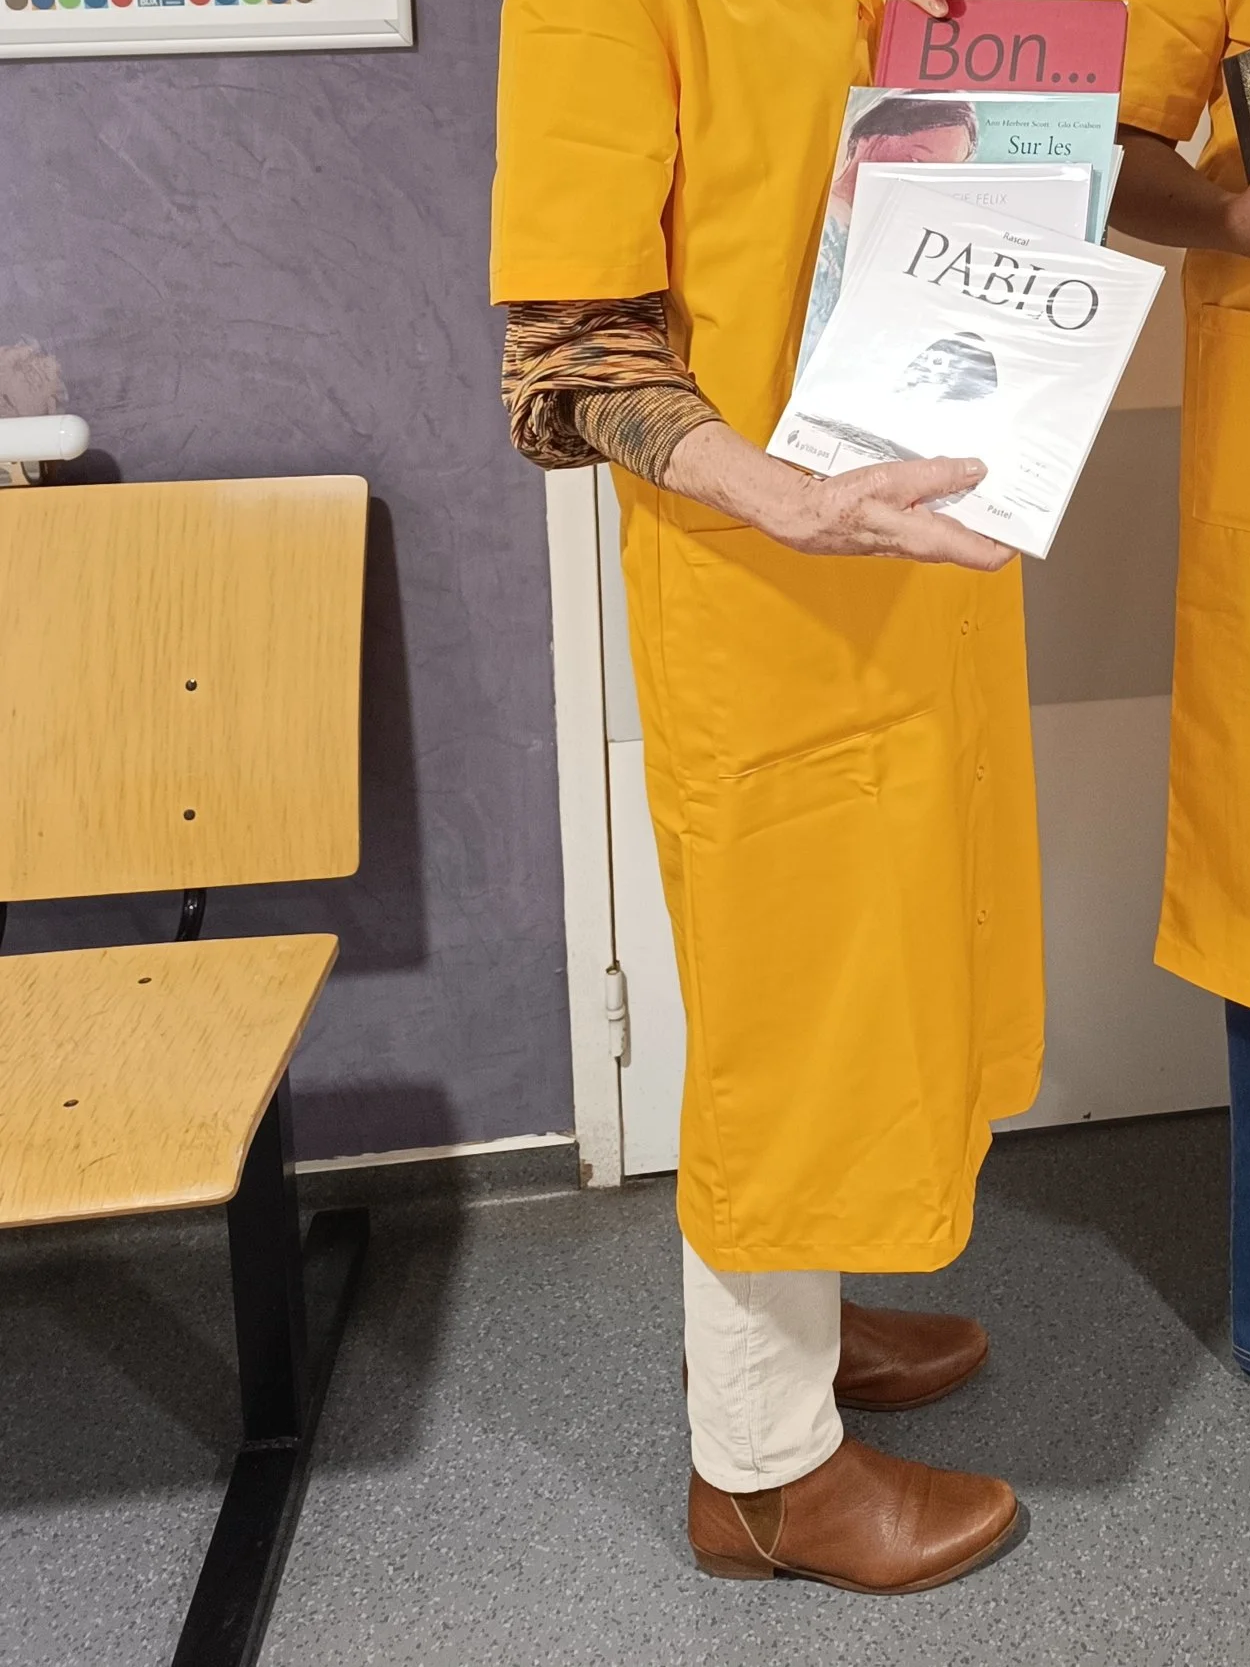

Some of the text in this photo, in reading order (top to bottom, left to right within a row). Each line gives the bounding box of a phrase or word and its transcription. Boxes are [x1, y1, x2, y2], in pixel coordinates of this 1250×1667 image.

[918, 18, 1097, 83] Bon...
[1008, 135, 1072, 156] Sur les
[1003, 231, 1030, 246] Rascal
[903, 227, 1099, 331] PABLO
[987, 504, 1013, 520] Pastel
